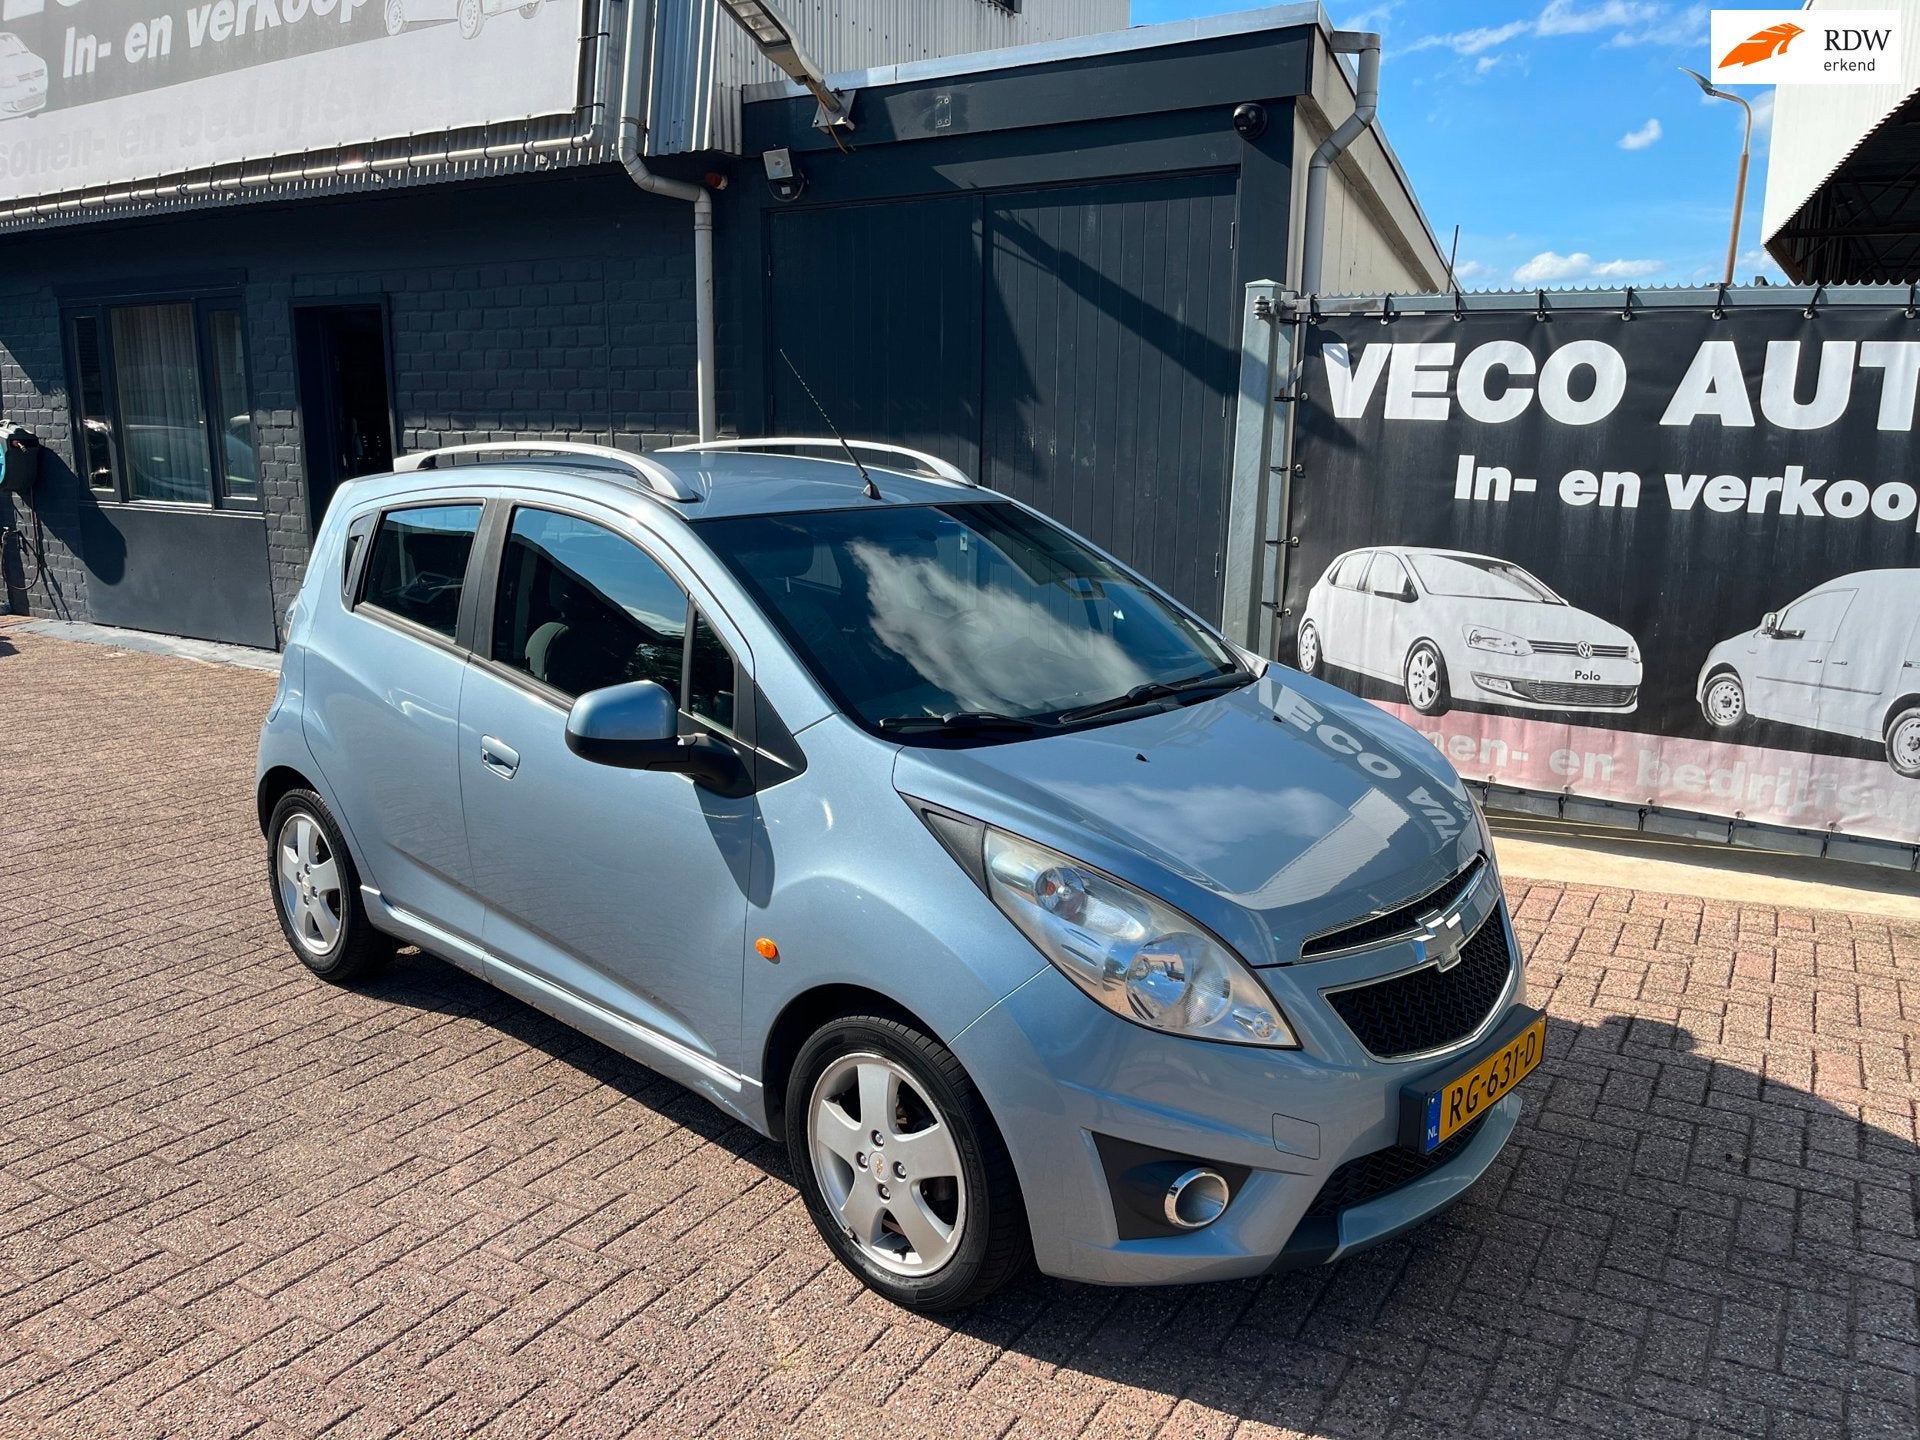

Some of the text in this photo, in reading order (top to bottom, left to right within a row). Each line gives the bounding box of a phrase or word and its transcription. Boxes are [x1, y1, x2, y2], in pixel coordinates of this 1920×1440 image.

[62, 26, 112, 79] In-
[124, 14, 173, 63] en
[1322, 340, 1627, 425] VECO
[1454, 455, 1920, 533] In- en verkoo
[1574, 670, 1601, 681] Polo
[1550, 748, 1615, 782] en
[1448, 1030, 1536, 1129] RG-631-D
[1427, 1128, 1438, 1141] NL
